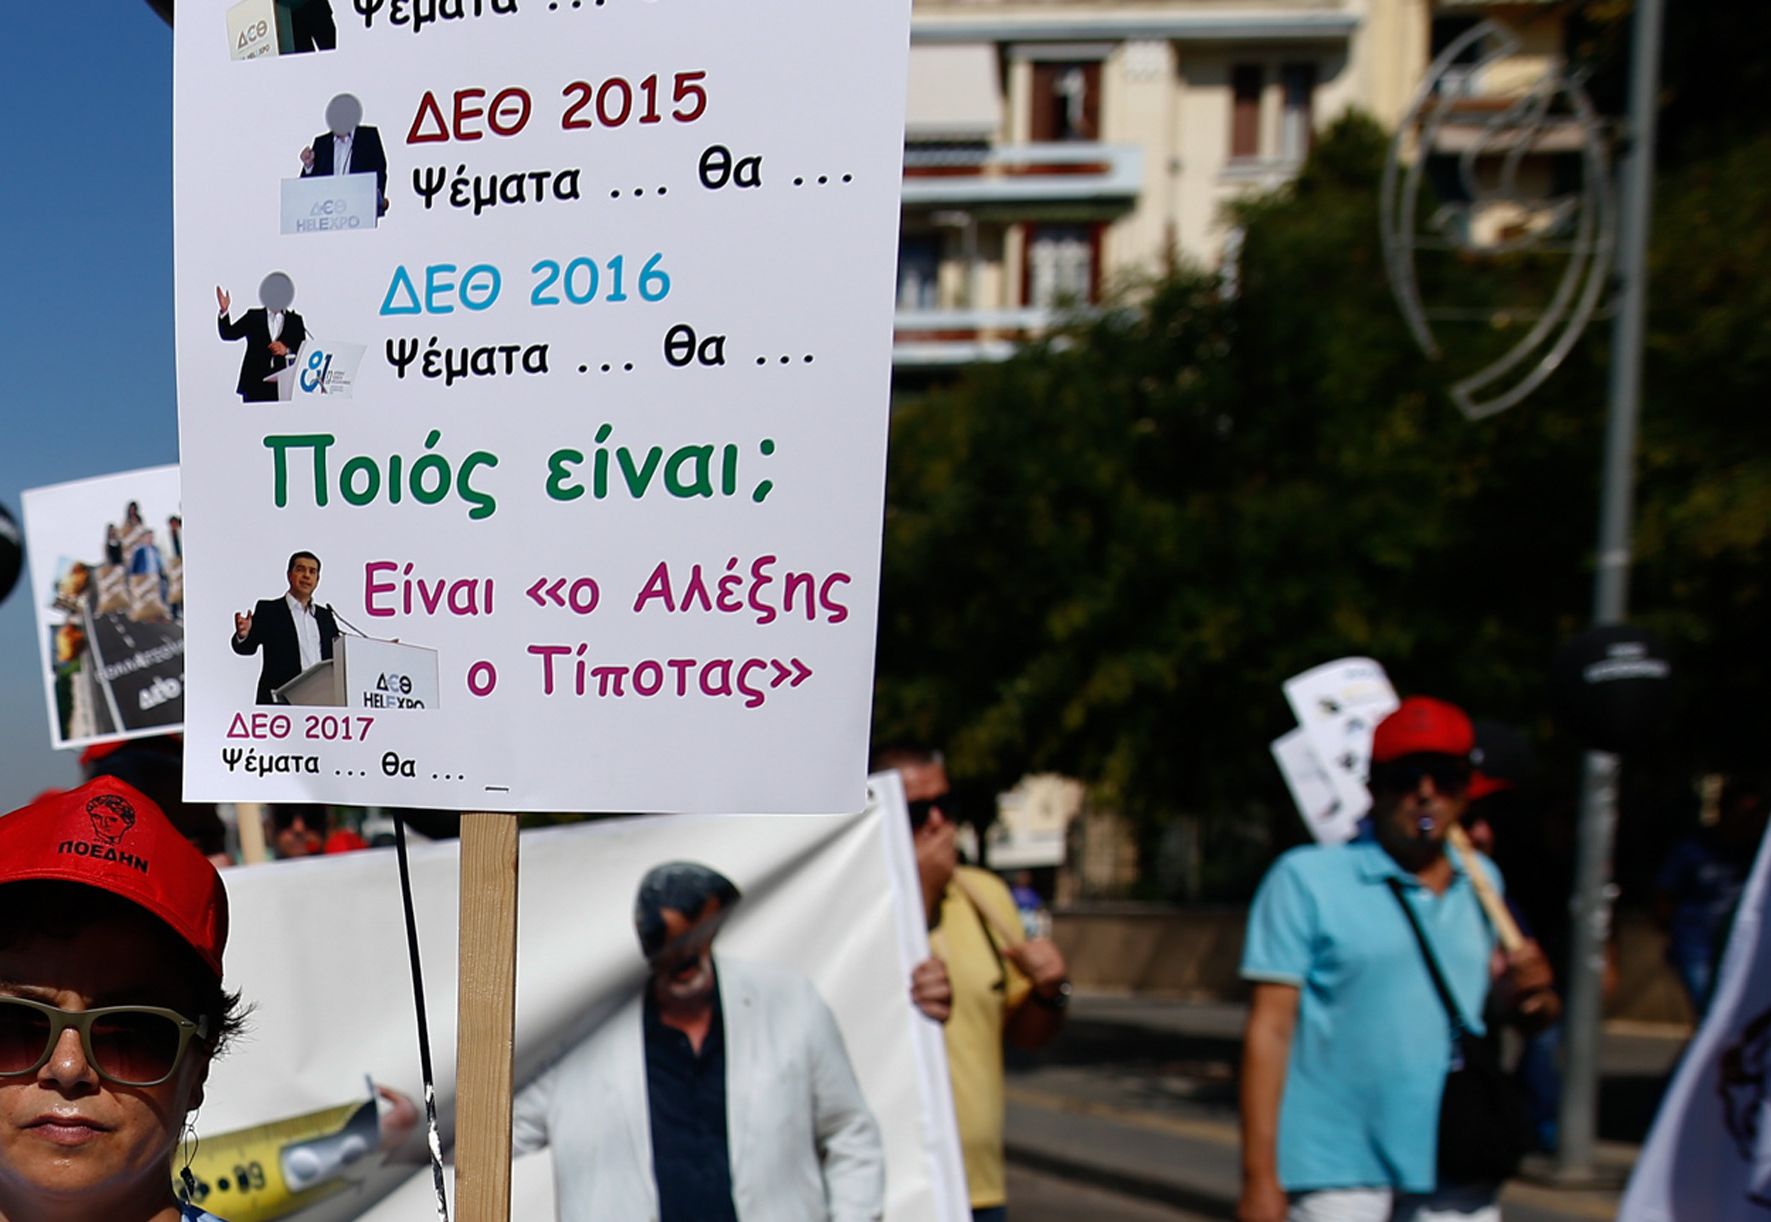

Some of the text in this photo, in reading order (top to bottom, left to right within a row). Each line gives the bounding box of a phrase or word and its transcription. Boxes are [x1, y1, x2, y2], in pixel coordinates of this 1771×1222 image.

[405, 70, 708, 145] ΔΕΘ 2015
[412, 164, 581, 215] Ψέματα
[296, 215, 360, 232] HELEXPO
[378, 252, 672, 317] ΔΕΘ 2016
[385, 337, 549, 386] Ψέματα
[263, 423, 776, 520] Ποιός είναι;
[363, 560, 495, 618] Είναι
[633, 555, 852, 625] Αλέξης
[527, 644, 813, 709] Τίποτας»
[226, 712, 375, 743] ΔΕΘ 2017
[221, 747, 321, 777] Ψέματα
[57, 839, 149, 874] ΠΟΕΔΗΝ
